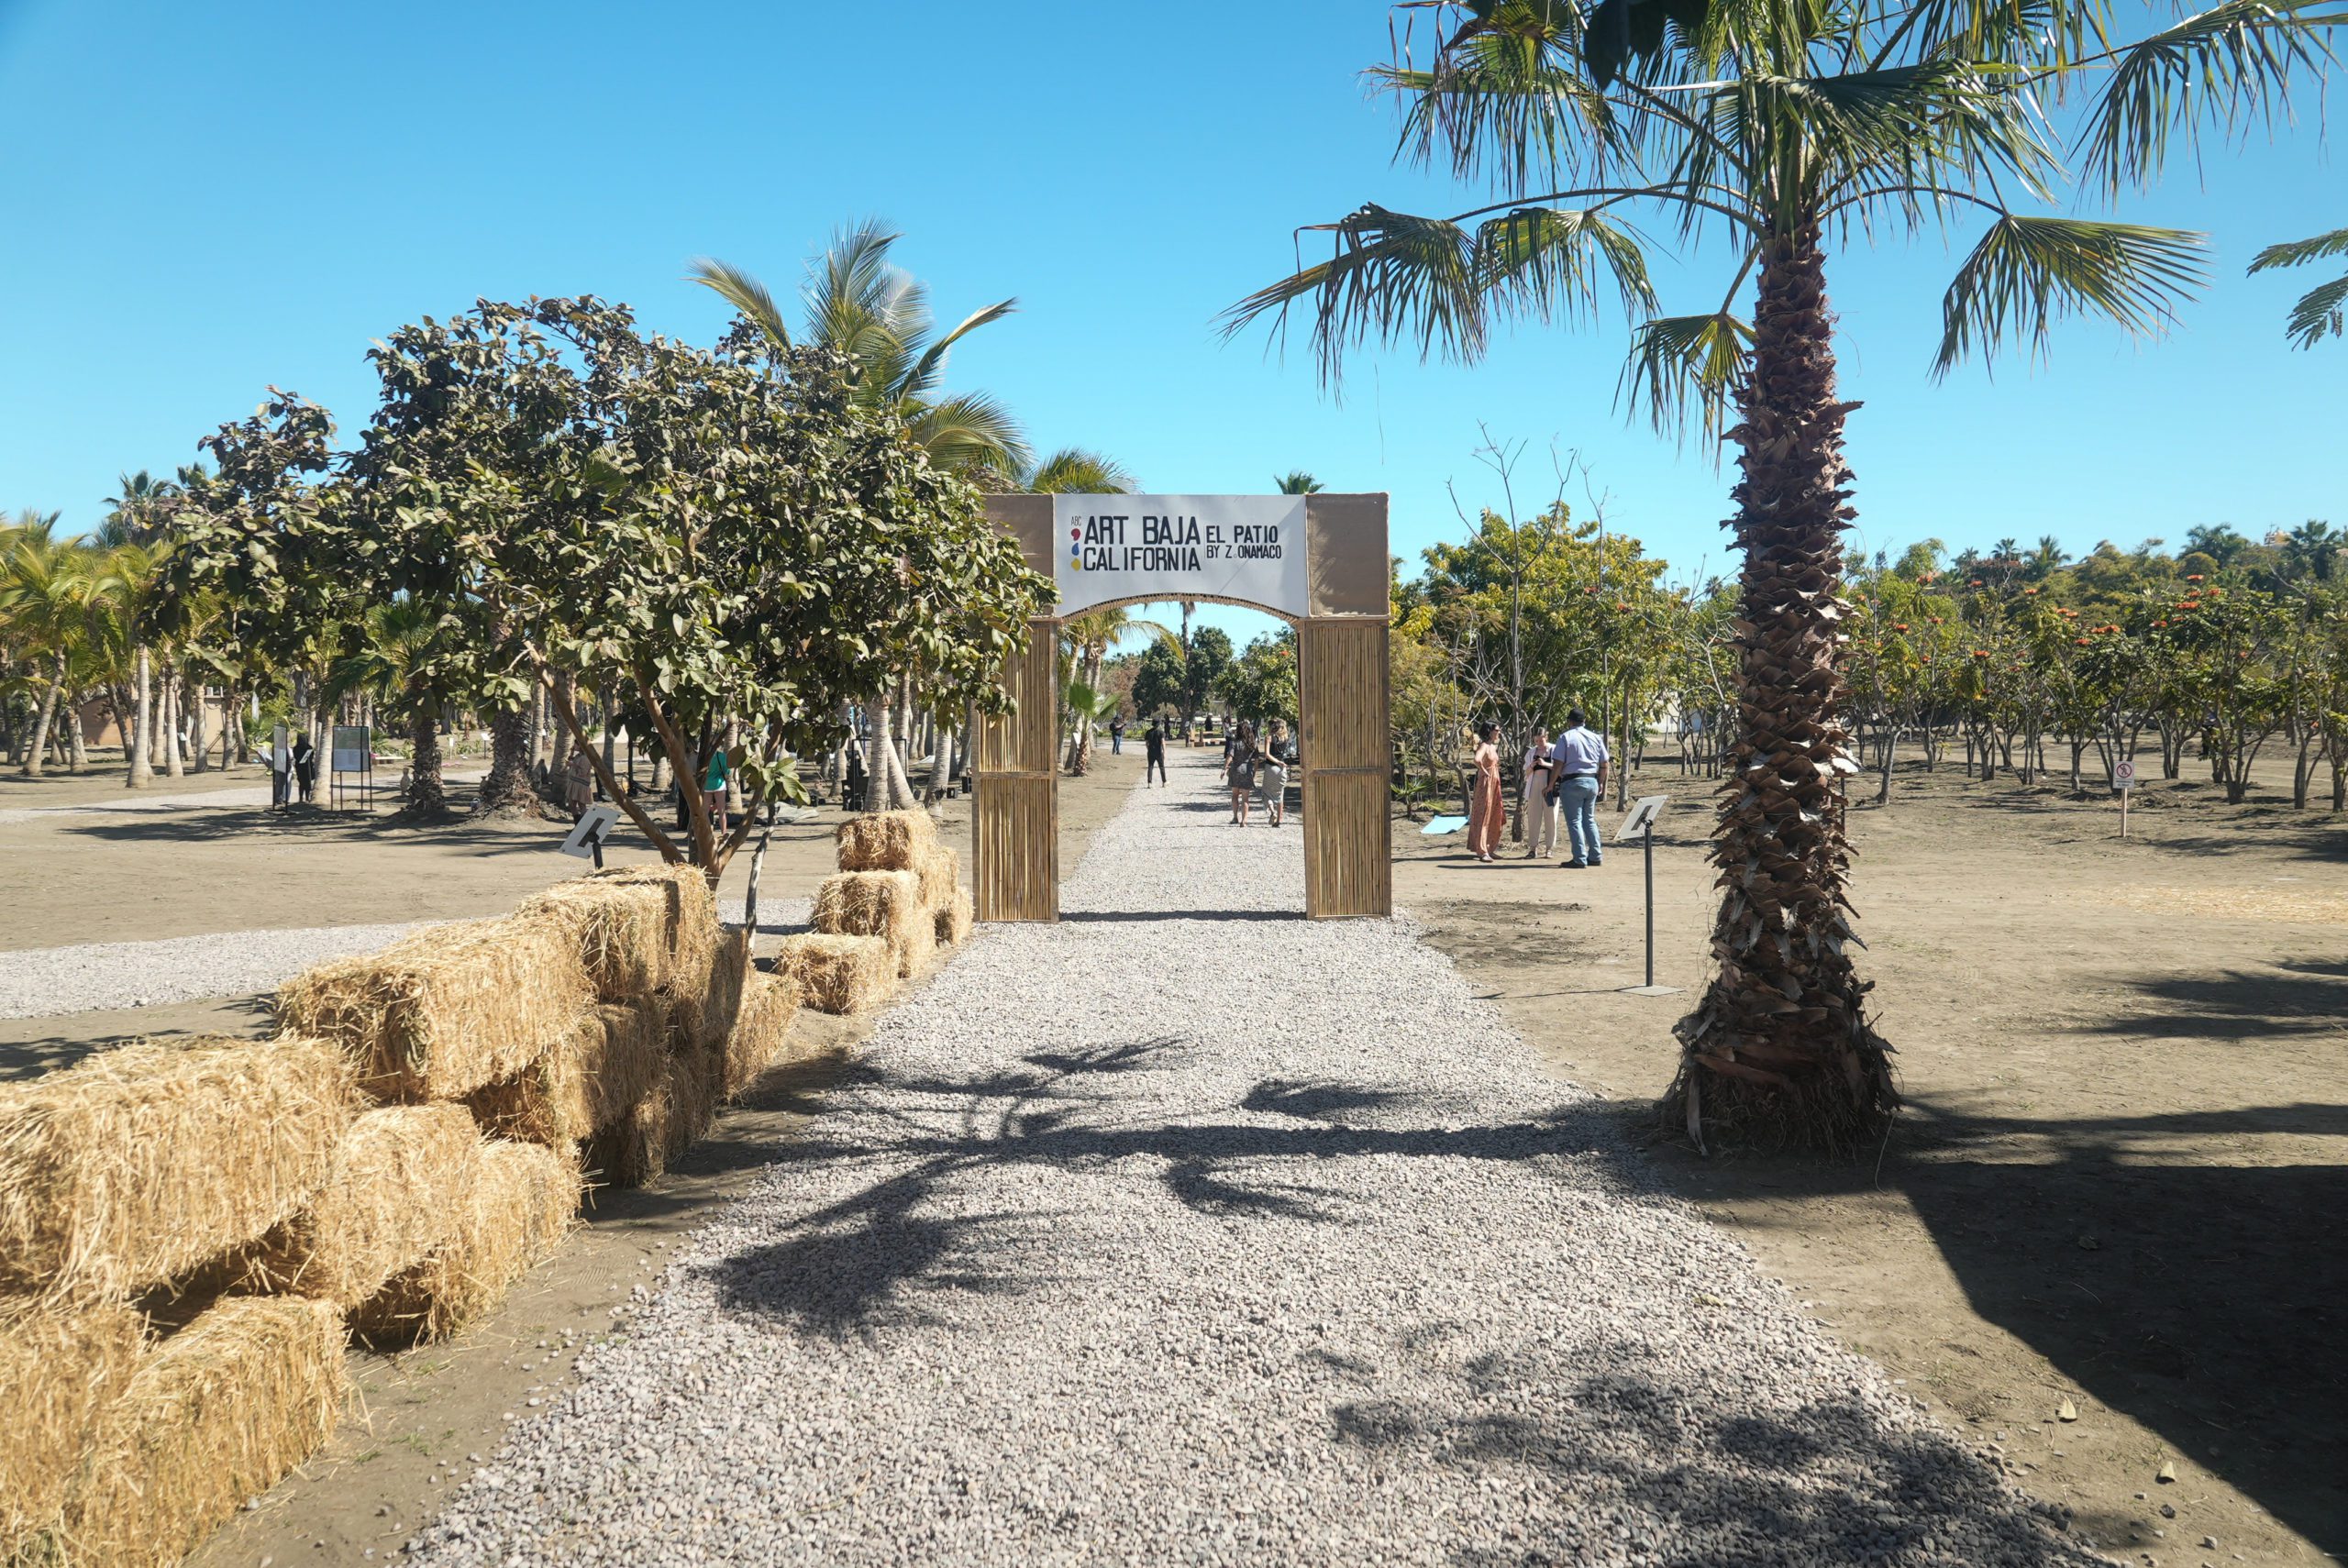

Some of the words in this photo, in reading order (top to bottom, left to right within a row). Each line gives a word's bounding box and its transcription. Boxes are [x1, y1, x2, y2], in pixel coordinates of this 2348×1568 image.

[1071, 516, 1081, 526] ABC
[1084, 515, 1129, 545] ART
[1143, 515, 1201, 545] BAJA
[1206, 525, 1225, 543] EL
[1234, 525, 1278, 543] PATIO
[1083, 547, 1202, 571] CALIFORNIA
[1206, 545, 1220, 558] BY
